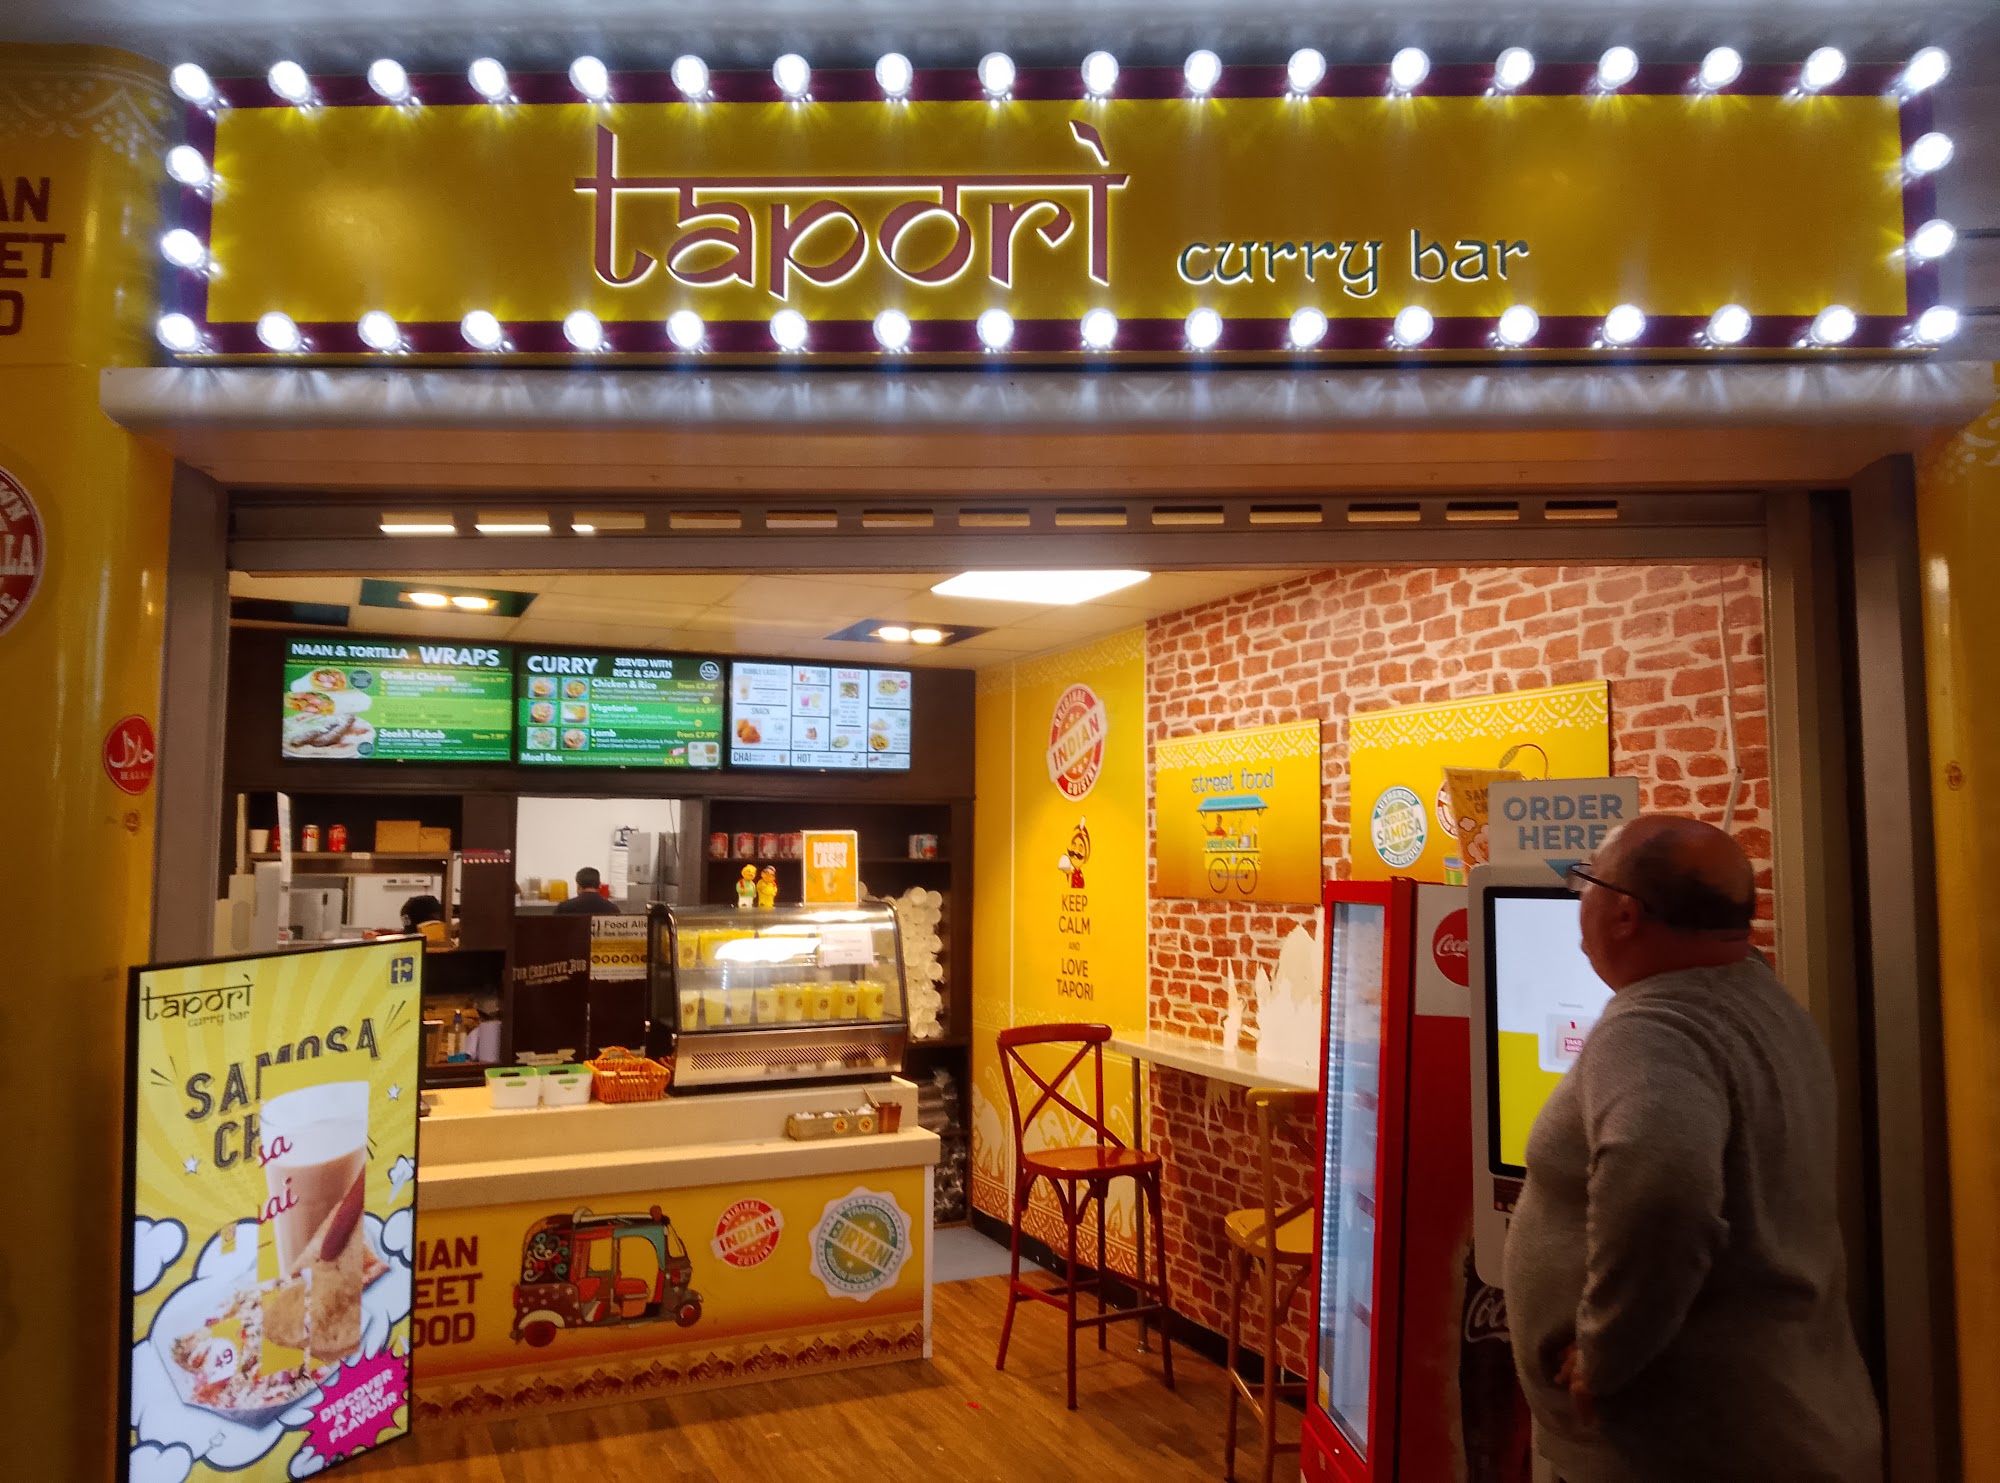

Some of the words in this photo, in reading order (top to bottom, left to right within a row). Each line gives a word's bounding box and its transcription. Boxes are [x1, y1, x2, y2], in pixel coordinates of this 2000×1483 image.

[1176, 240, 1383, 298] curry
[1410, 228, 1529, 282] bar
[291, 643, 332, 656] NAAN
[335, 645, 347, 657] &
[350, 645, 409, 659] TORTILLA
[418, 646, 500, 667] WRAPS
[614, 658, 648, 667] SERVED
[650, 658, 672, 669] WITH
[527, 656, 598, 675] CURRY
[643, 671, 672, 679] SALAD
[591, 679, 627, 689] Chicken
[629, 681, 637, 689] &
[638, 681, 657, 690] Rice
[592, 703, 638, 714] Vegetarian
[591, 728, 616, 737] Lamb
[1053, 713, 1099, 770] INDIAN
[521, 753, 542, 762] Meal
[545, 754, 562, 762] Box
[733, 752, 751, 762] CHAI
[797, 754, 811, 763] HOT
[1191, 771, 1235, 794] street
[1241, 767, 1275, 790] food
[1380, 808, 1414, 828] INDIAN
[1503, 794, 1623, 822] ORDER
[1376, 817, 1423, 847] SAMOSA
[1518, 825, 1608, 850] HERE
[1062, 895, 1088, 912] KEEP
[604, 920, 628, 928] Food
[1058, 916, 1090, 935] CALM
[1068, 942, 1081, 950] AND
[1061, 957, 1088, 977] LOVE
[1056, 979, 1094, 1000] TAPORI
[229, 1011, 249, 1021] bar
[719, 1215, 776, 1252] INDIAN
[828, 1220, 895, 1269] BIRYANI
[320, 1368, 393, 1423] DISCOVER
[334, 1413, 347, 1428] A
[350, 1386, 384, 1417] NEW
[329, 1392, 397, 1444] FLAVOUR
